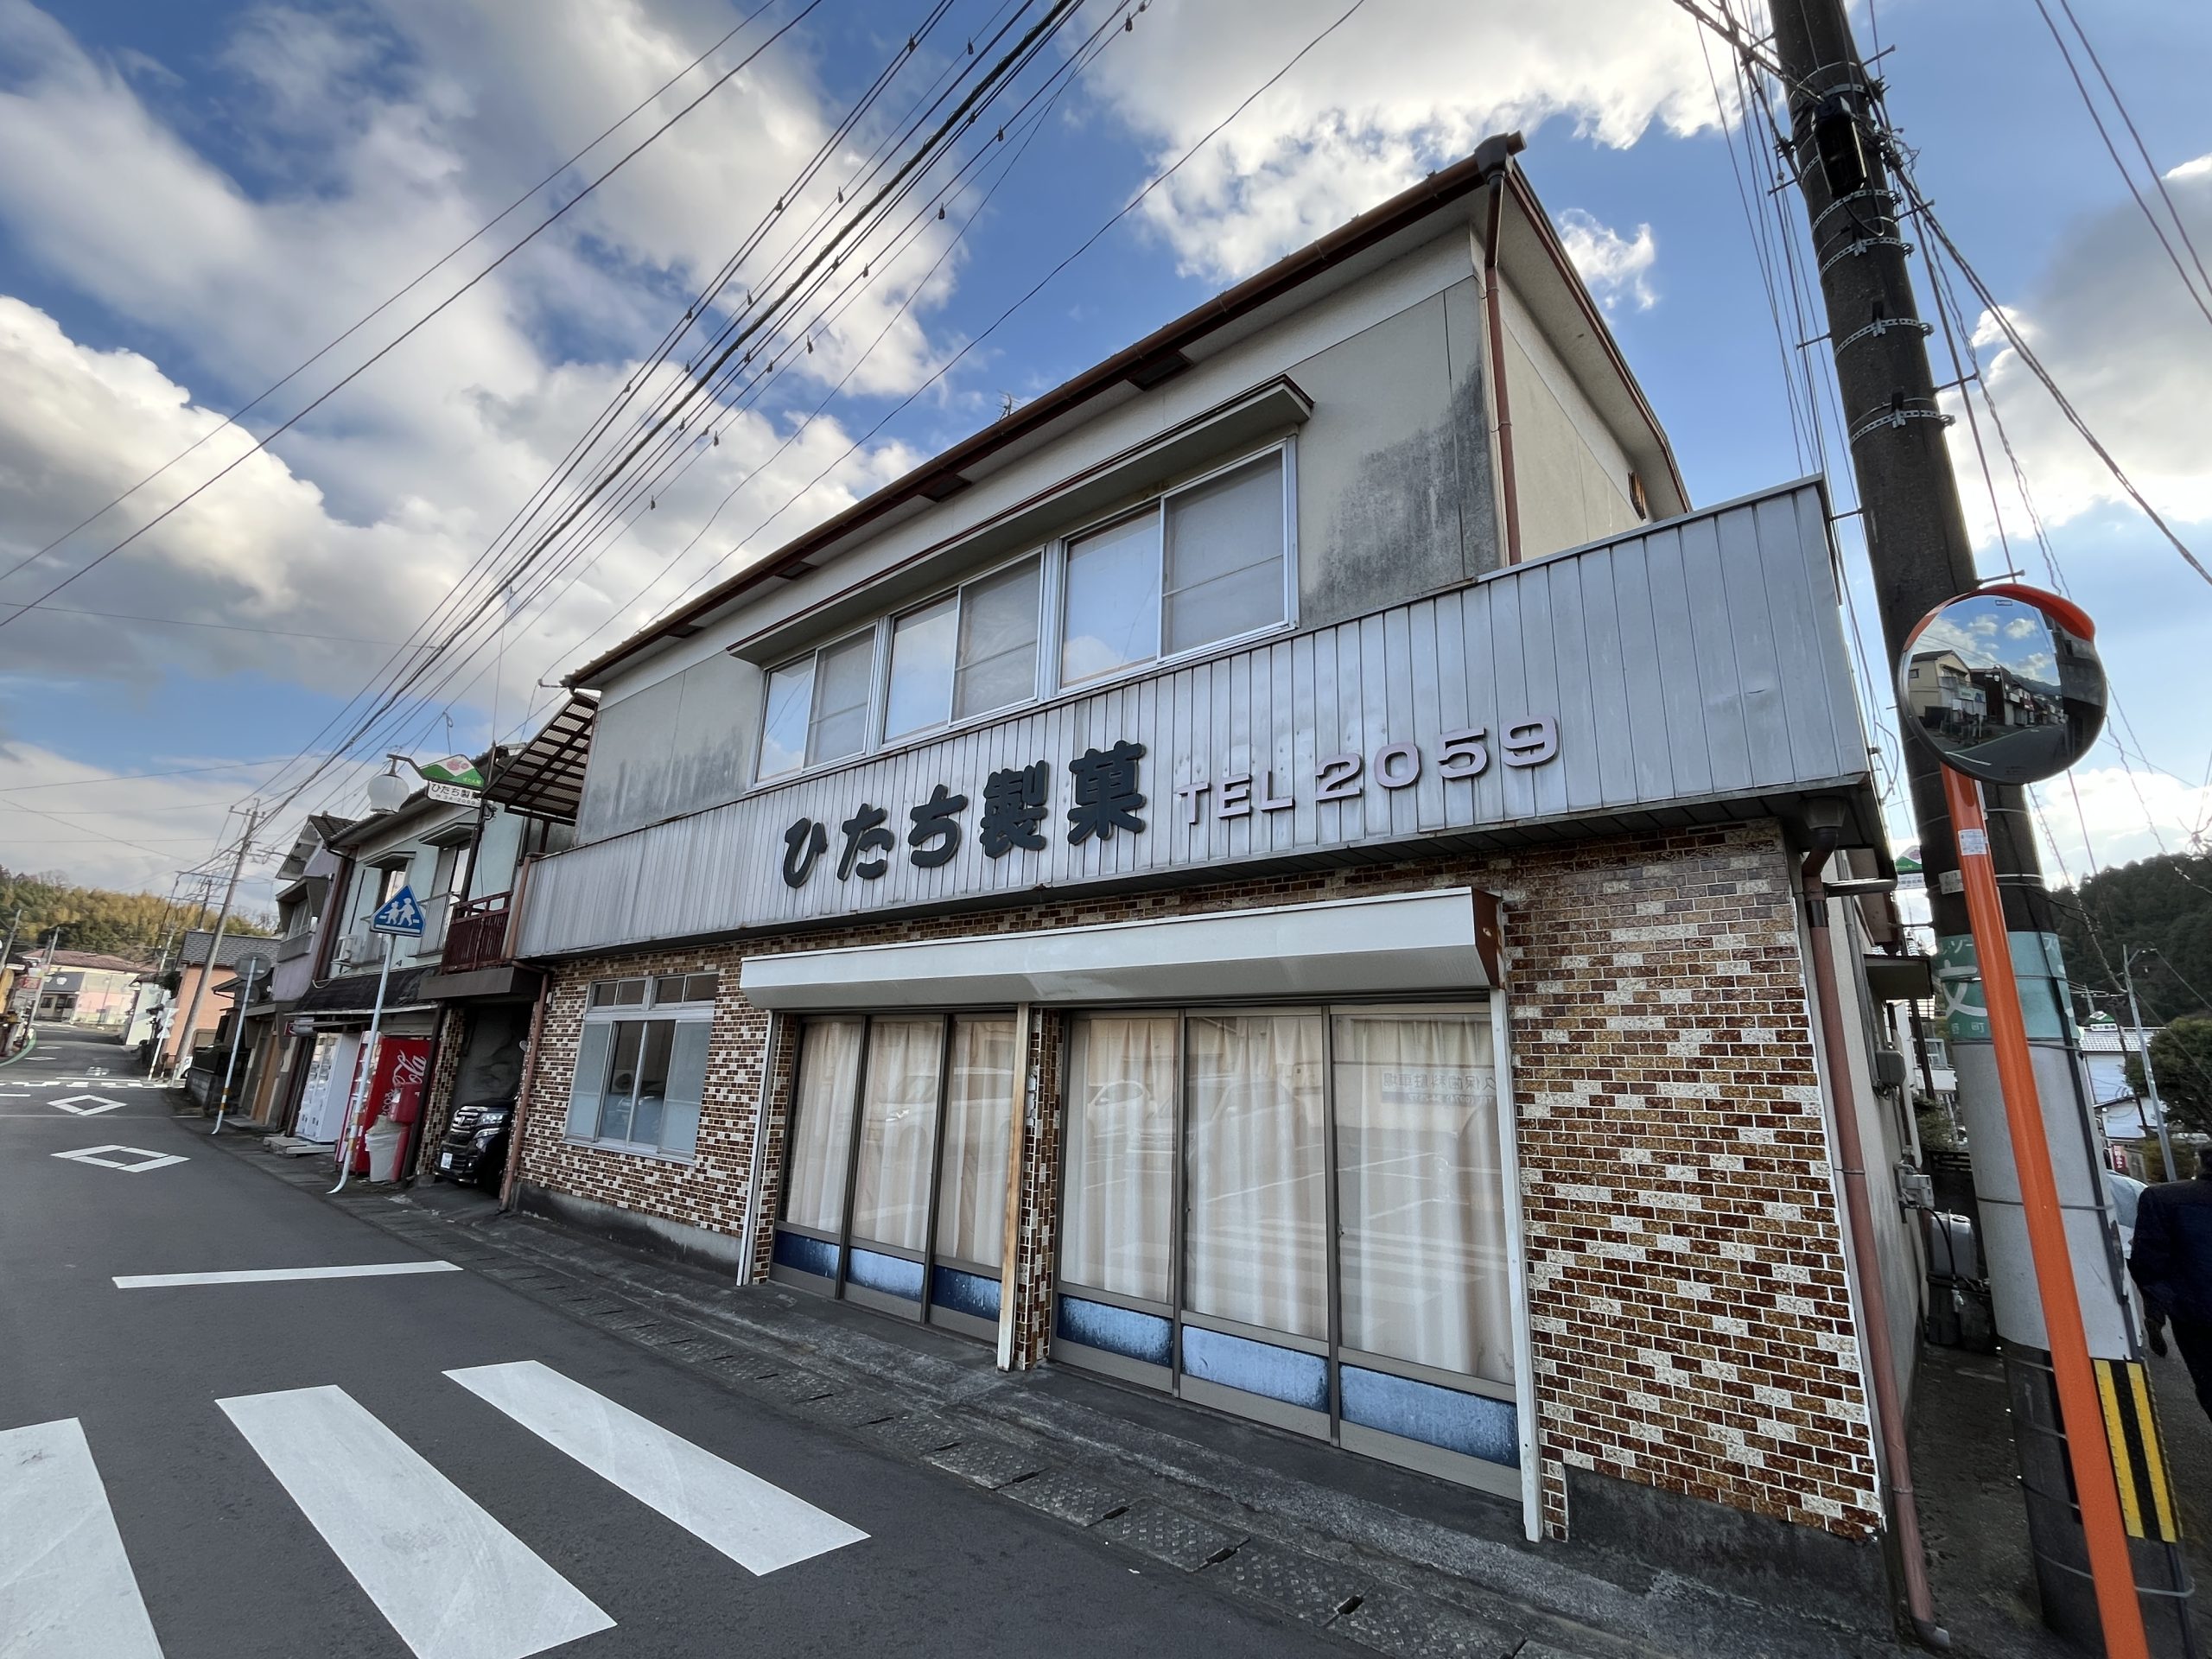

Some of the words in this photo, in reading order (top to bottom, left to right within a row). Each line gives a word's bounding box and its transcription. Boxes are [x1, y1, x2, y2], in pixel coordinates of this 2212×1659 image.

[783, 741, 1147, 887] ひたち製菓
[1177, 771, 1295, 825] TEL
[1315, 715, 1558, 801] 2059
